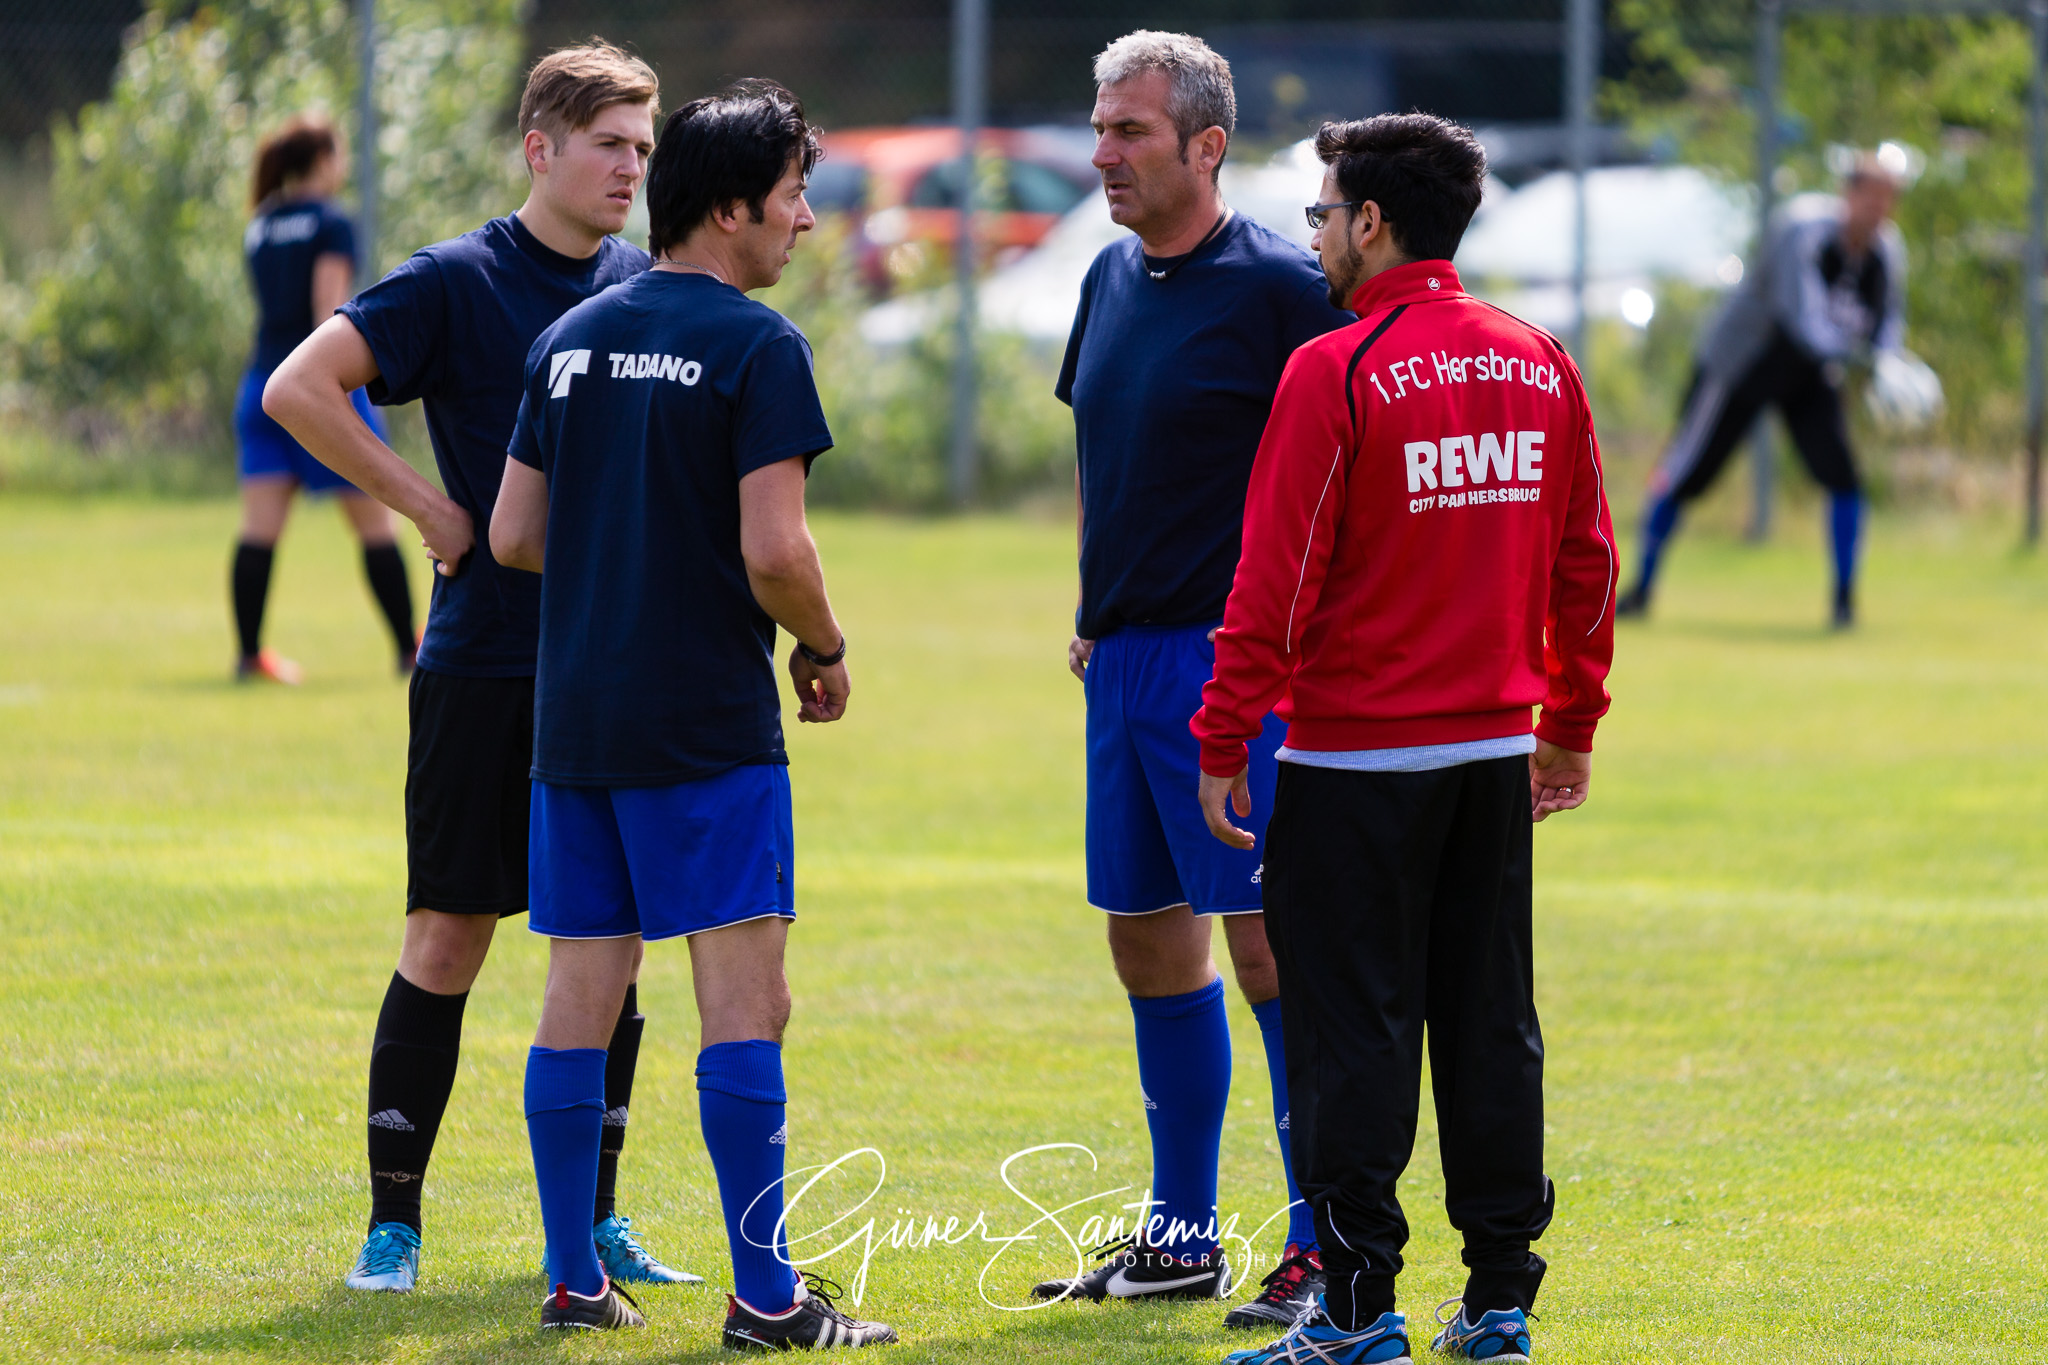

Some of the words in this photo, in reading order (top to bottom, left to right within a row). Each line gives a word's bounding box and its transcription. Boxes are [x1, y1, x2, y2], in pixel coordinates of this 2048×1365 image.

[608, 352, 702, 386] TADANO
[1431, 347, 1561, 398] Hersbruck
[1404, 431, 1545, 493] REWE
[1409, 495, 1436, 514] CITY
[368, 1116, 415, 1131] adidas
